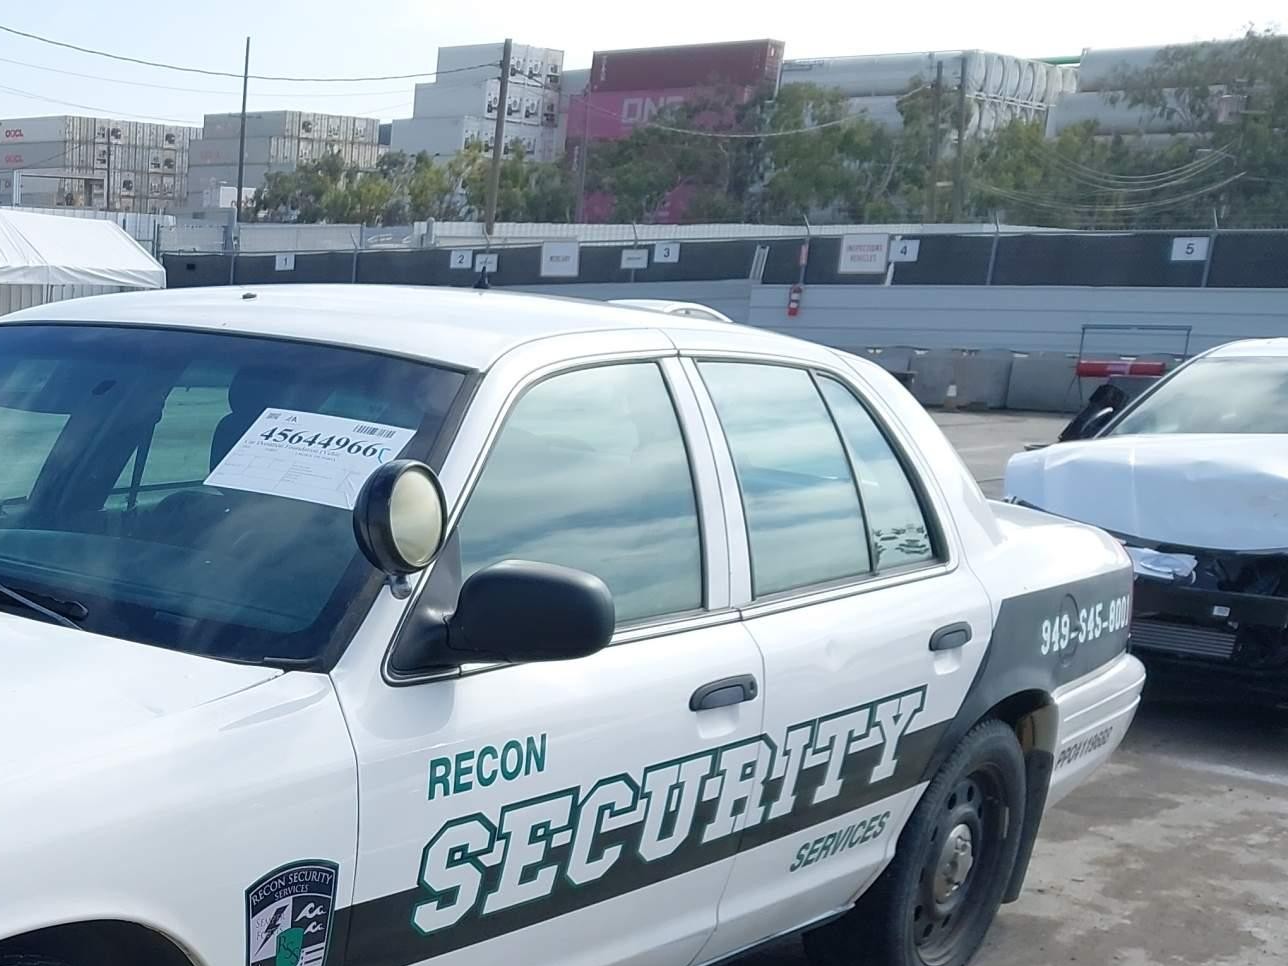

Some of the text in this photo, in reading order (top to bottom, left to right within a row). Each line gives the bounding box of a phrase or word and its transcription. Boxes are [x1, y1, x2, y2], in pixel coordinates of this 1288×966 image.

[457, 255, 466, 264] 2
[663, 247, 671, 258] 3
[900, 245, 908, 256] 4
[1185, 242, 1195, 255] 5
[260, 426, 381, 458] 45644966
[428, 733, 547, 801] RECON
[411, 684, 929, 935] SECURITY
[789, 810, 892, 873] SERVICES
[252, 870, 333, 906] RECON SECURITY
[274, 884, 309, 901] SERVICES
